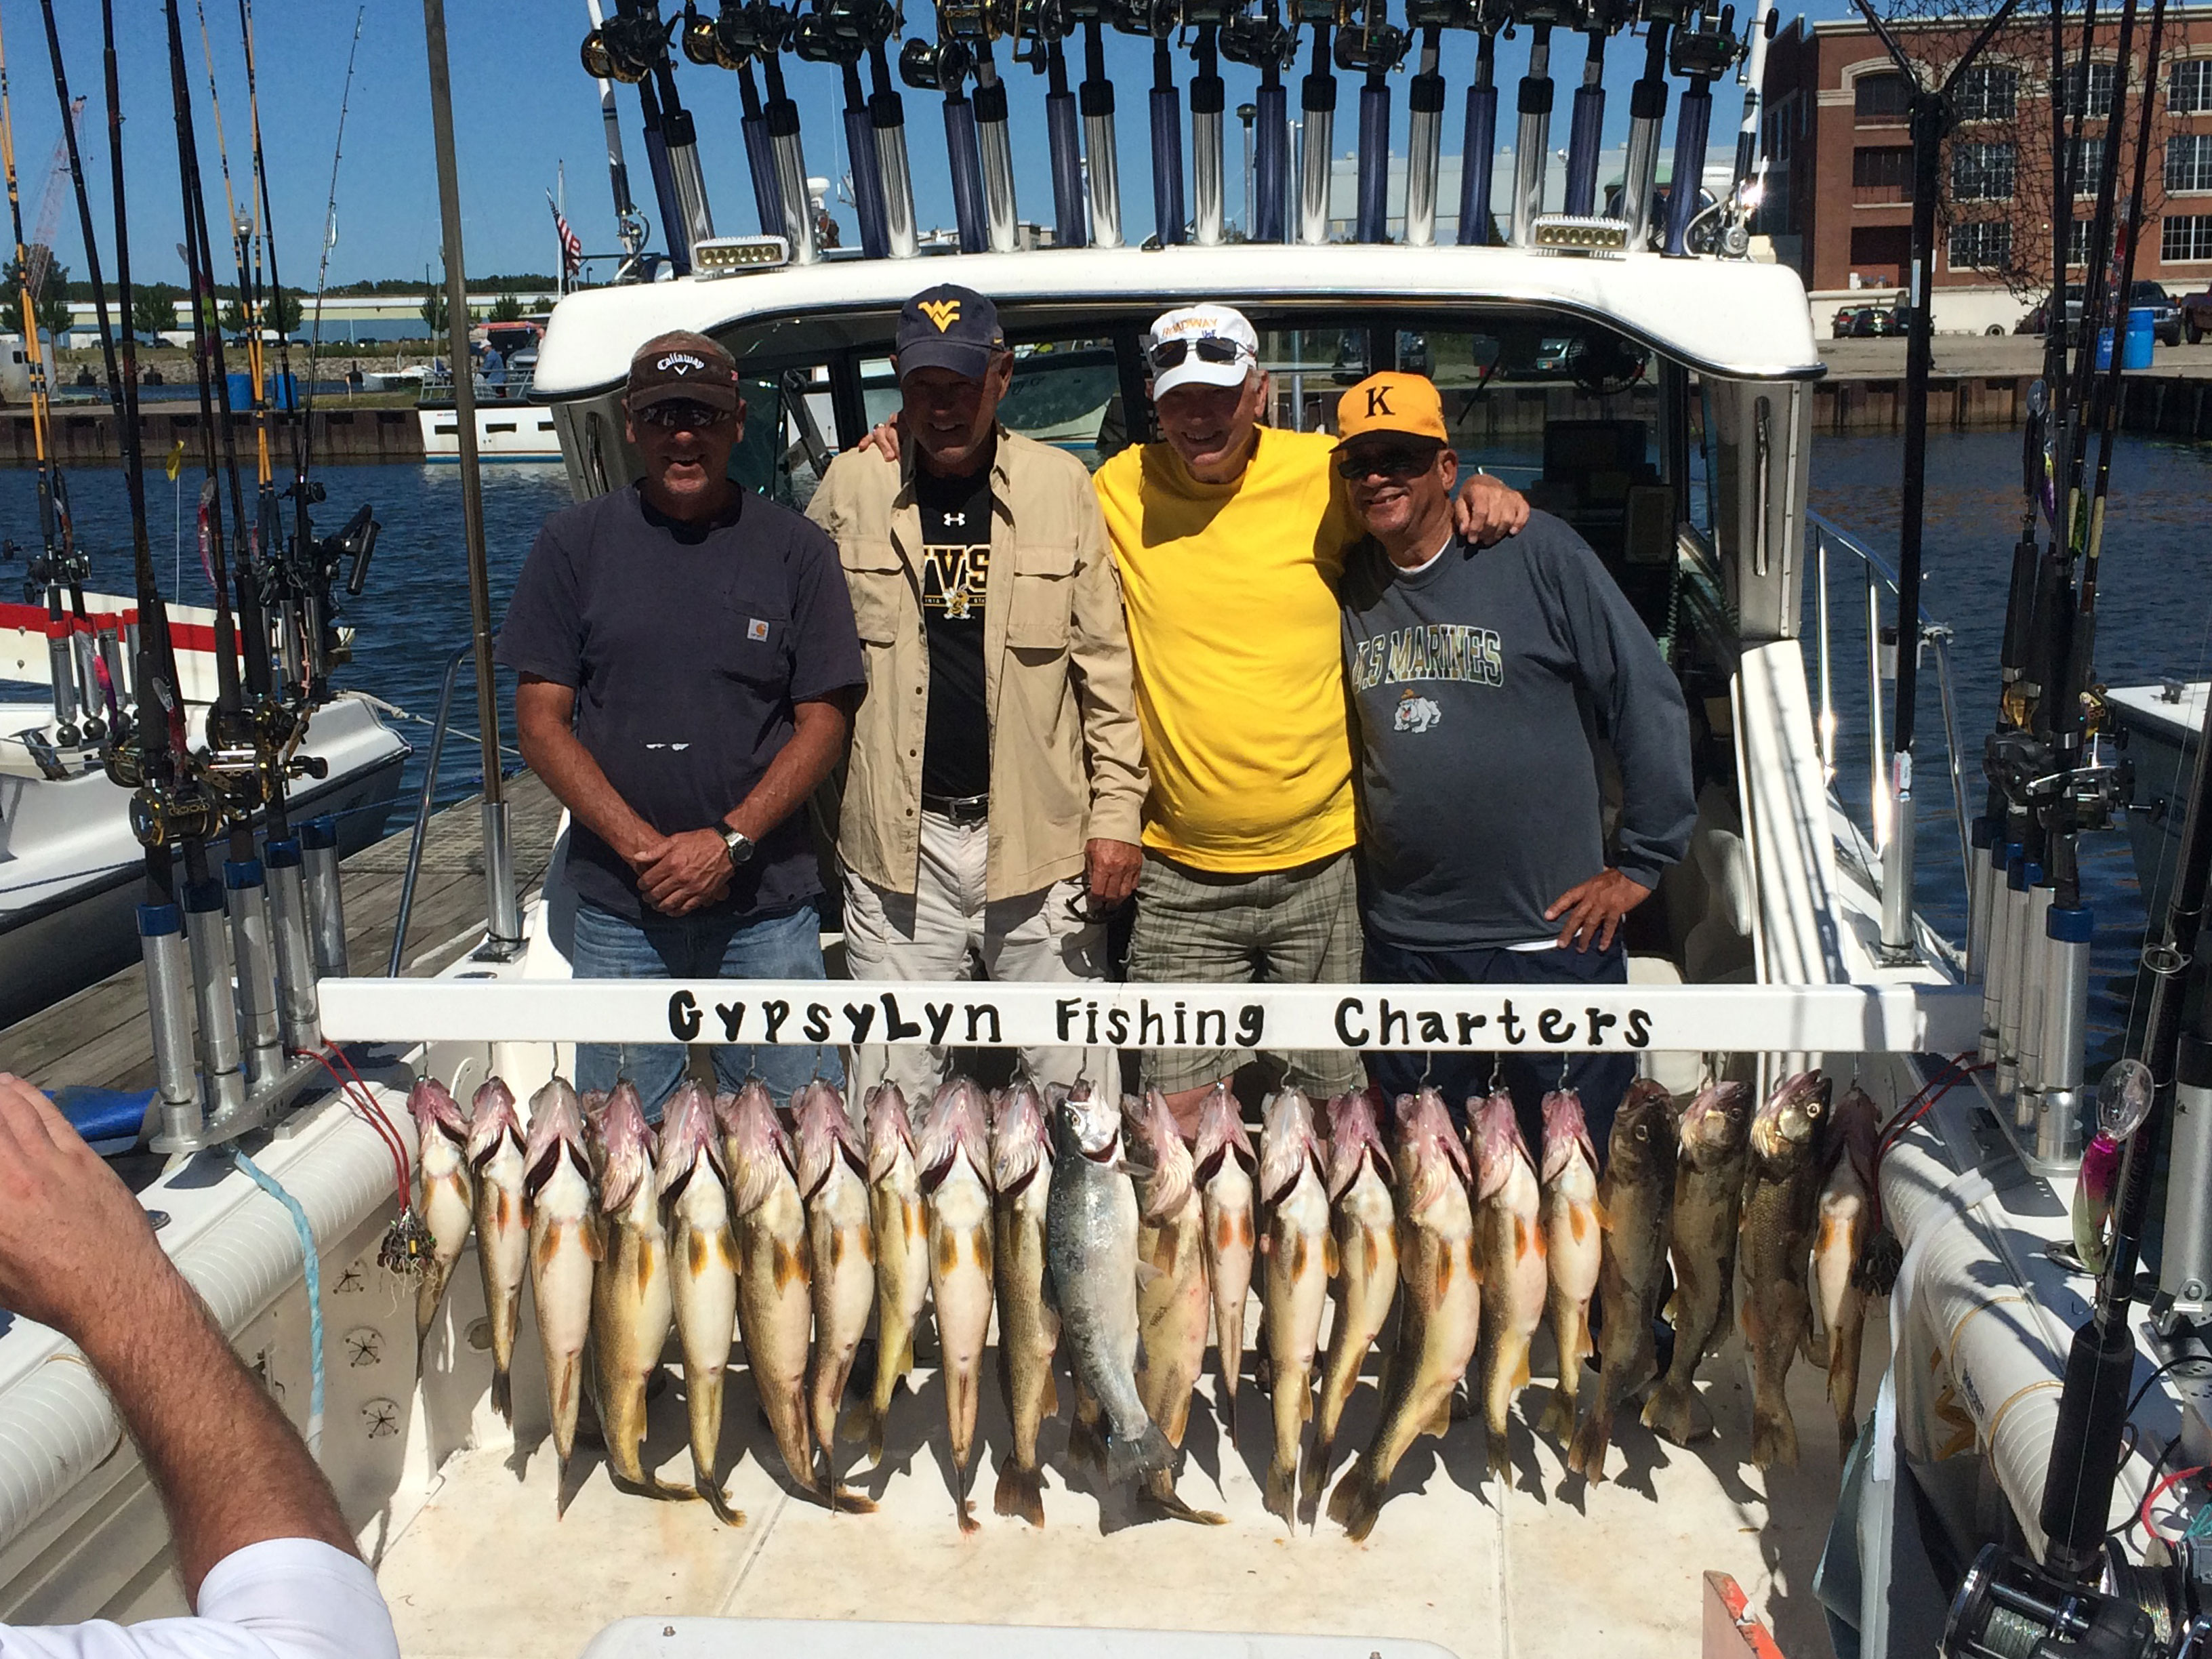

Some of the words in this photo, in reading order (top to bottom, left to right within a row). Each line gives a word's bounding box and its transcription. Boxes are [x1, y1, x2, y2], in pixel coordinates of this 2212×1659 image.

[657, 352, 705, 371] Callaway
[1364, 386, 1396, 419] K
[1385, 623, 1504, 688] MARINES
[668, 989, 1002, 1044] GypsyLyn
[1055, 997, 1265, 1047] Fishing
[1334, 996, 1653, 1048] Charters
